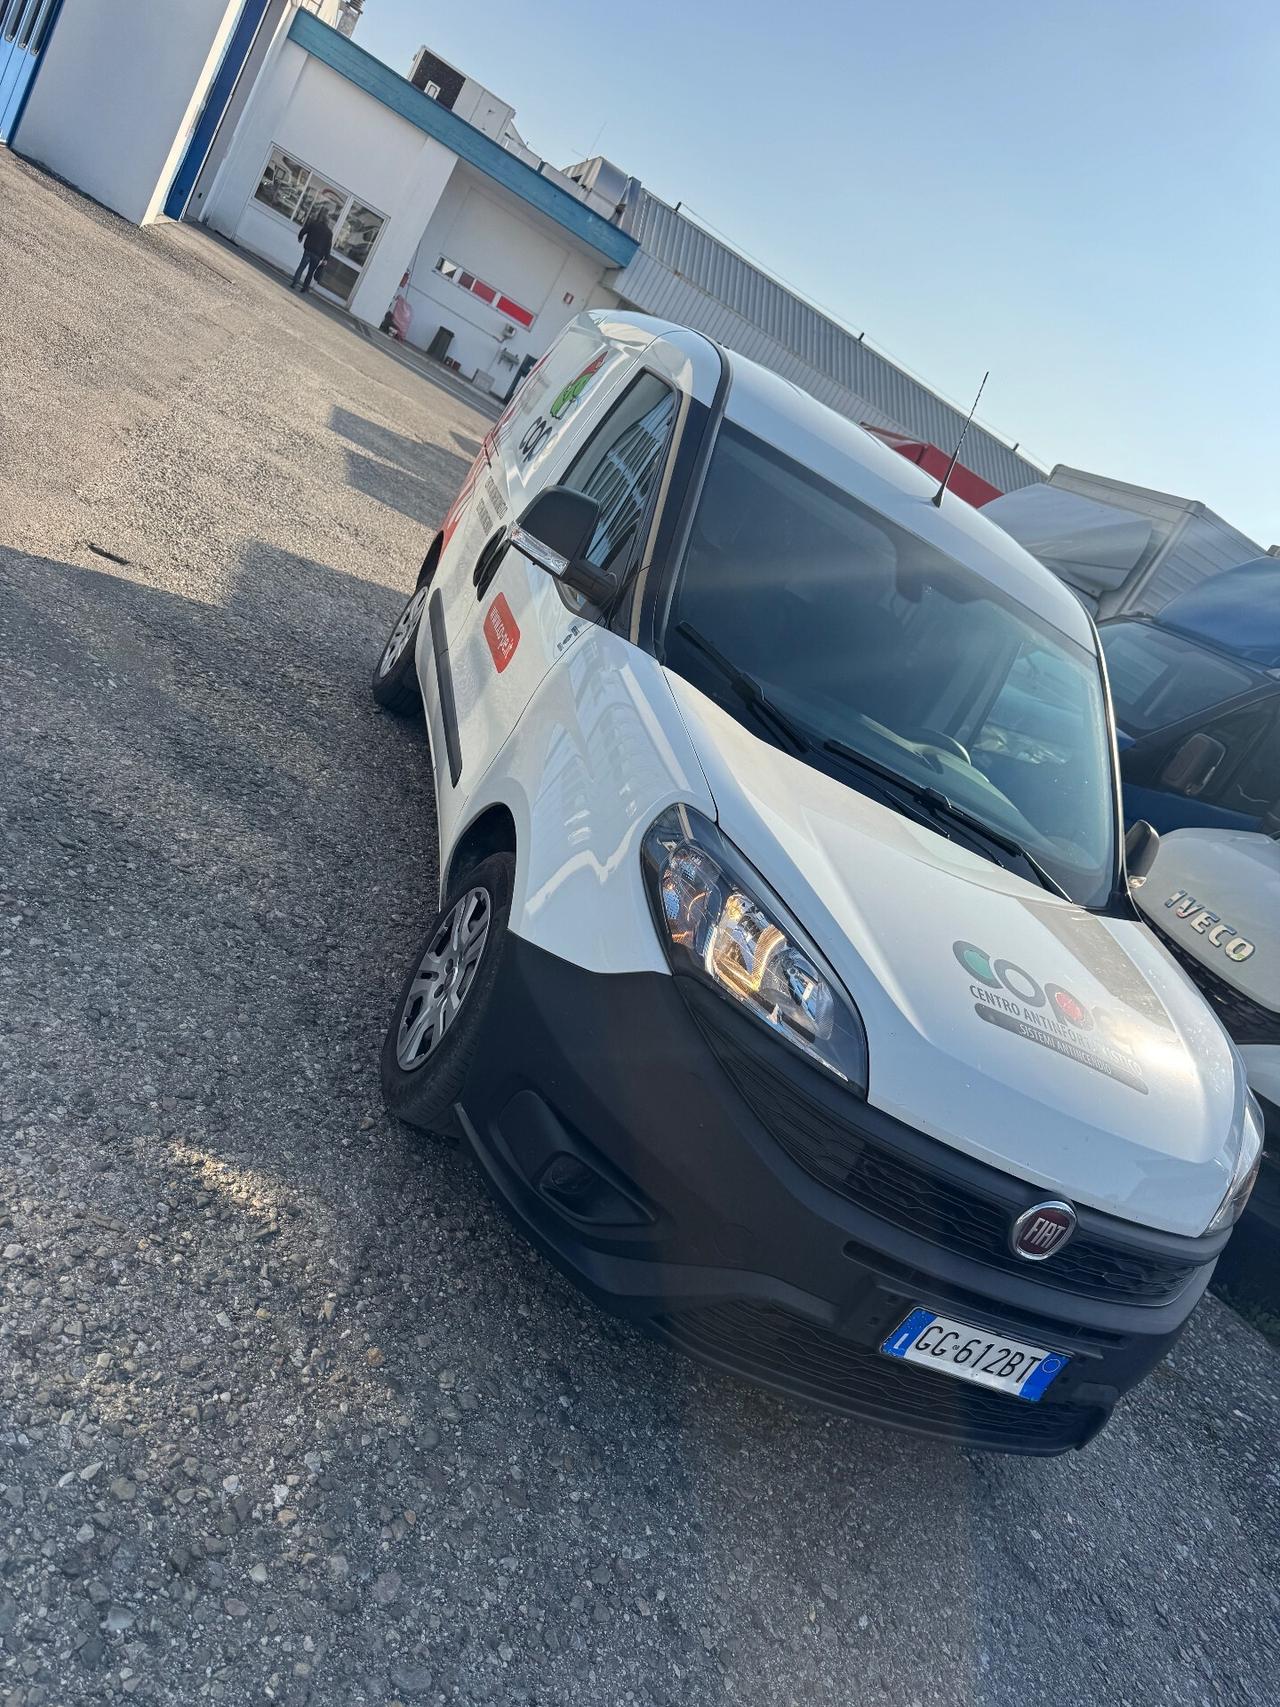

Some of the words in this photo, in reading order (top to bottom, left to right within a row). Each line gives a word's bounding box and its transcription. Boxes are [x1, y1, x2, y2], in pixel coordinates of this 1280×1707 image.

[1164, 889, 1256, 963] IVECO
[969, 984, 1021, 1017] CENTRO
[1018, 1023, 1055, 1049] SISTEMI
[1056, 1042, 1112, 1075] ANTINCENDIO
[1023, 1217, 1067, 1250] FIAT
